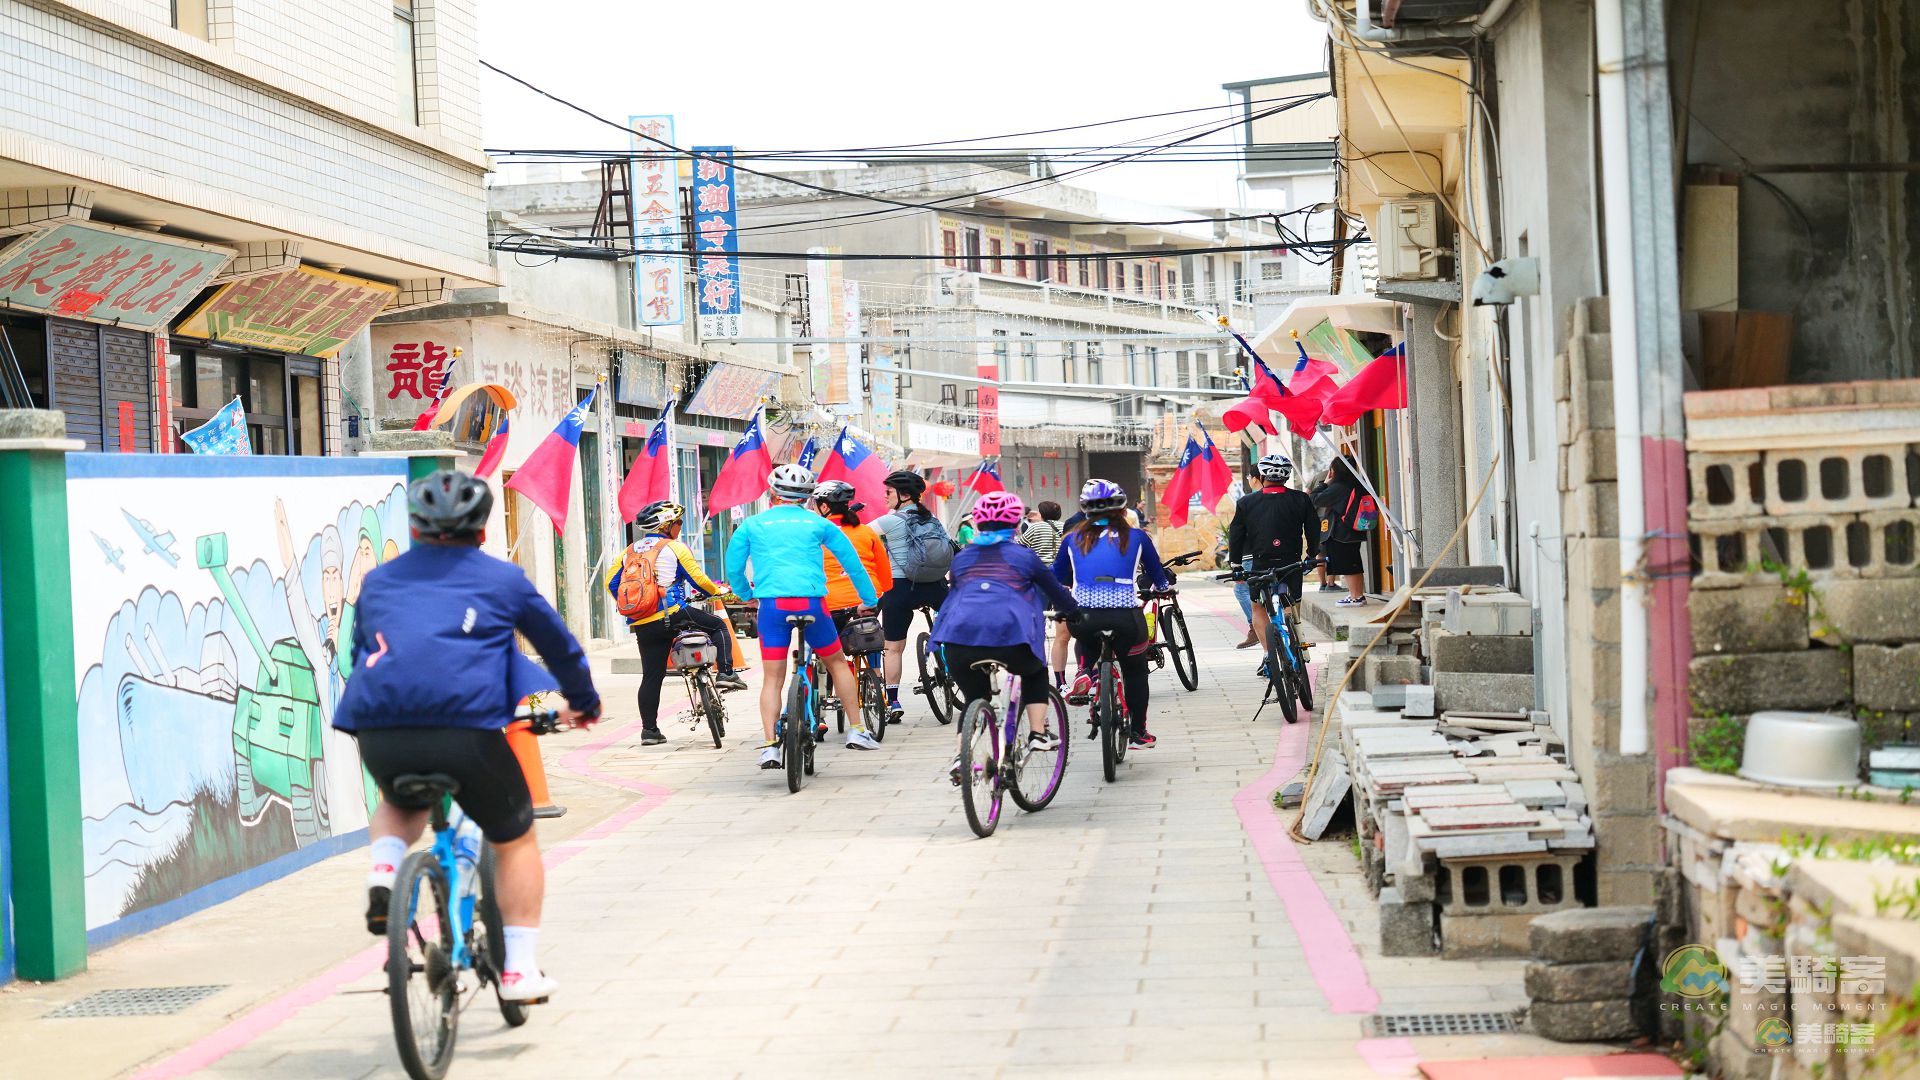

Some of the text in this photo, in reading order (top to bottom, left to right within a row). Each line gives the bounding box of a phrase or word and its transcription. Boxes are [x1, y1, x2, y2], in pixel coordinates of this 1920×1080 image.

[697, 152, 737, 311] 新潮時裝行
[386, 340, 454, 400] 龍
